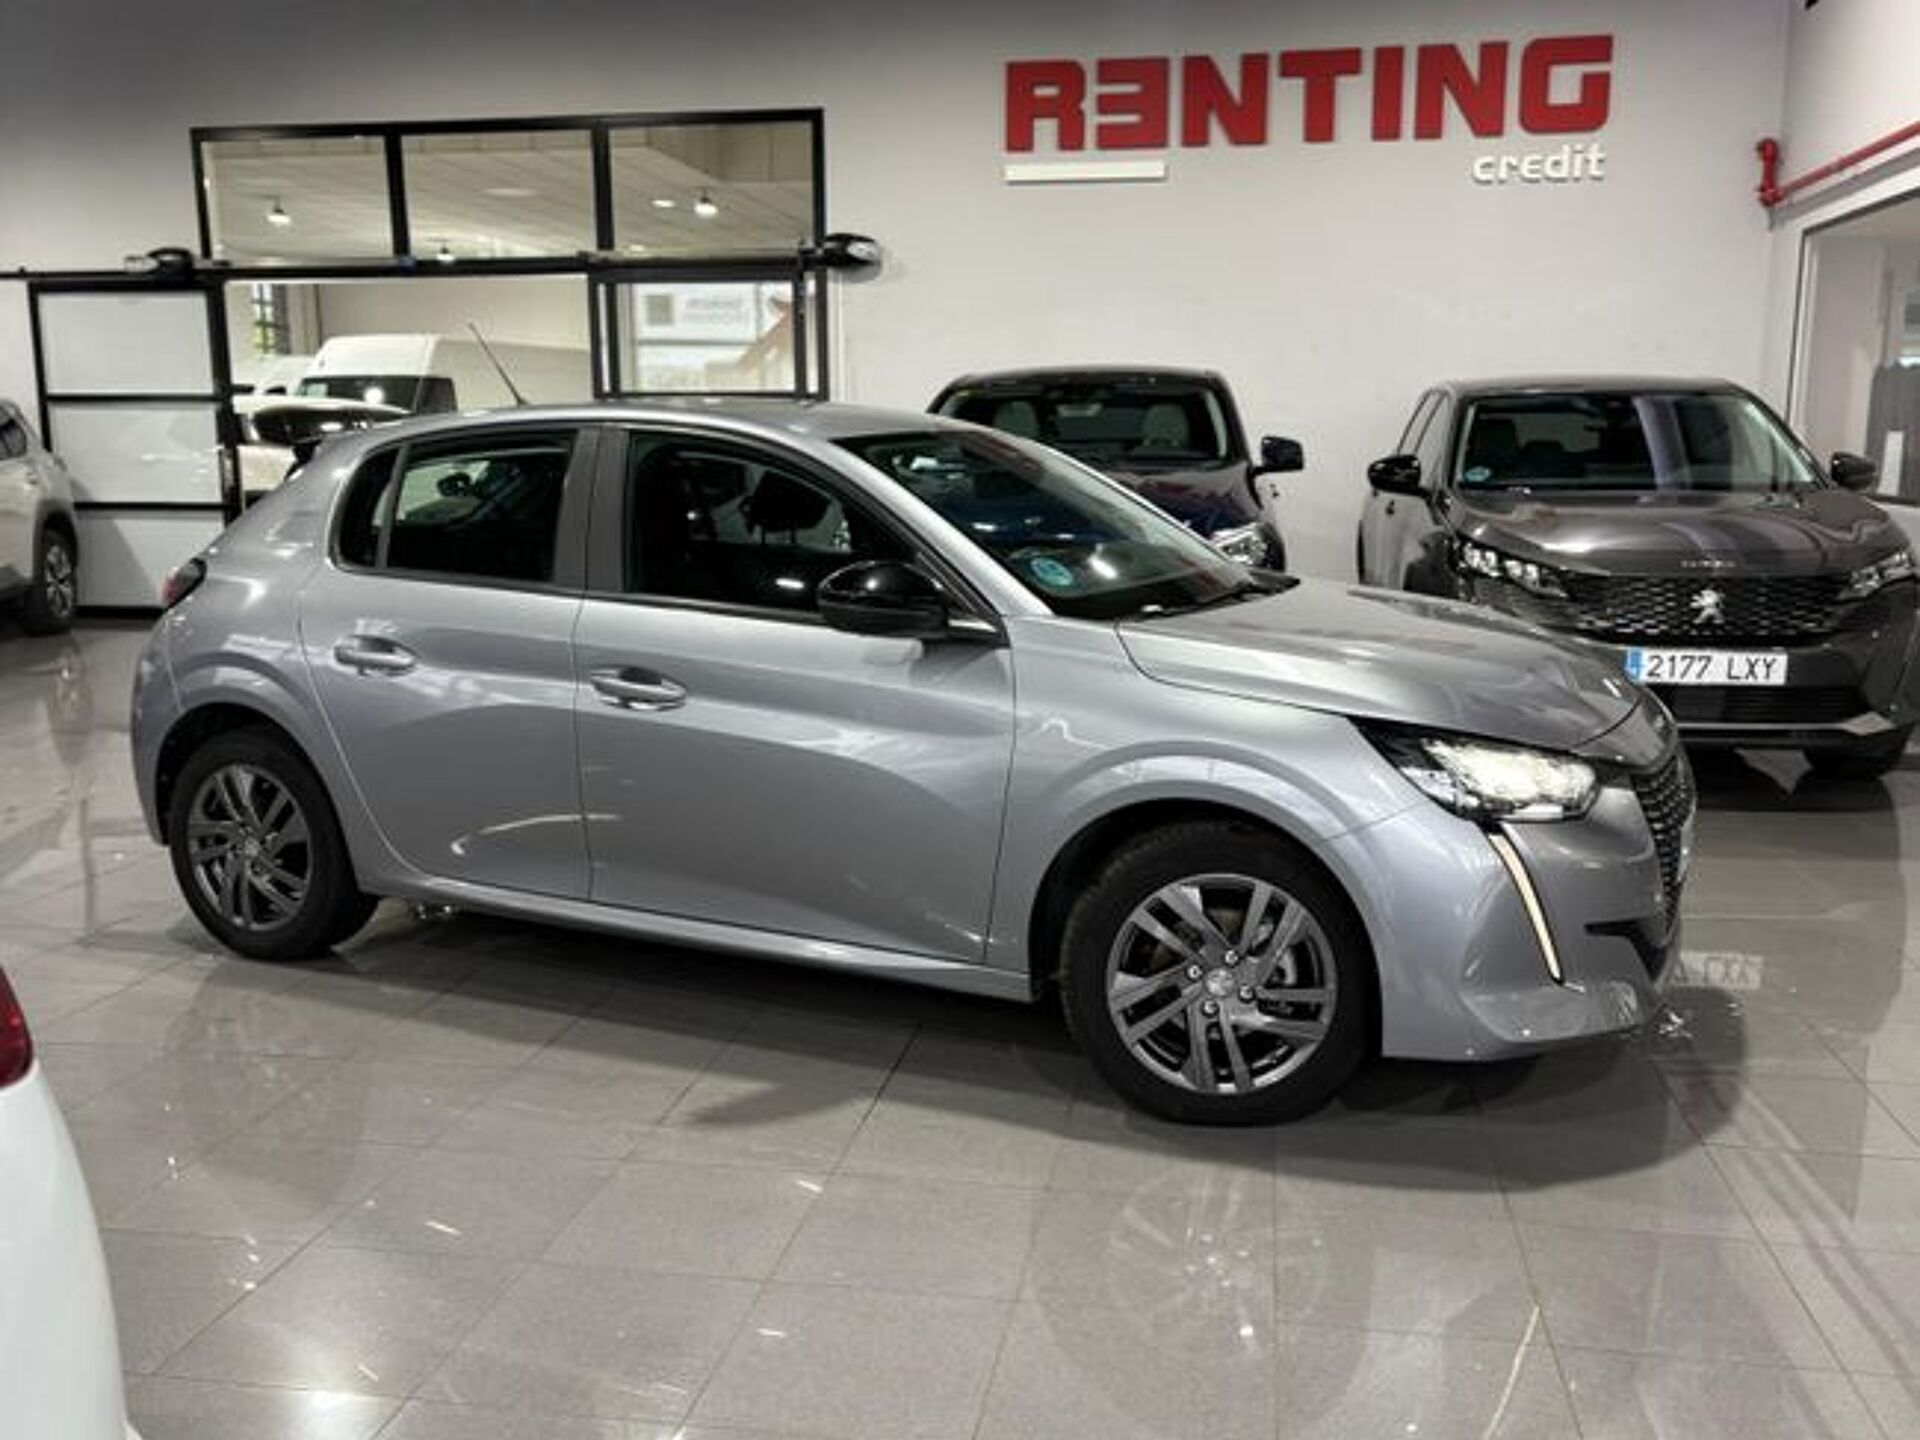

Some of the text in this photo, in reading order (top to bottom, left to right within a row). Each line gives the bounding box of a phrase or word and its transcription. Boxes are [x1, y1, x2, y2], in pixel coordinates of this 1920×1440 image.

[1472, 143, 1606, 183] credit
[1647, 654, 1778, 681] 2177 LXY
